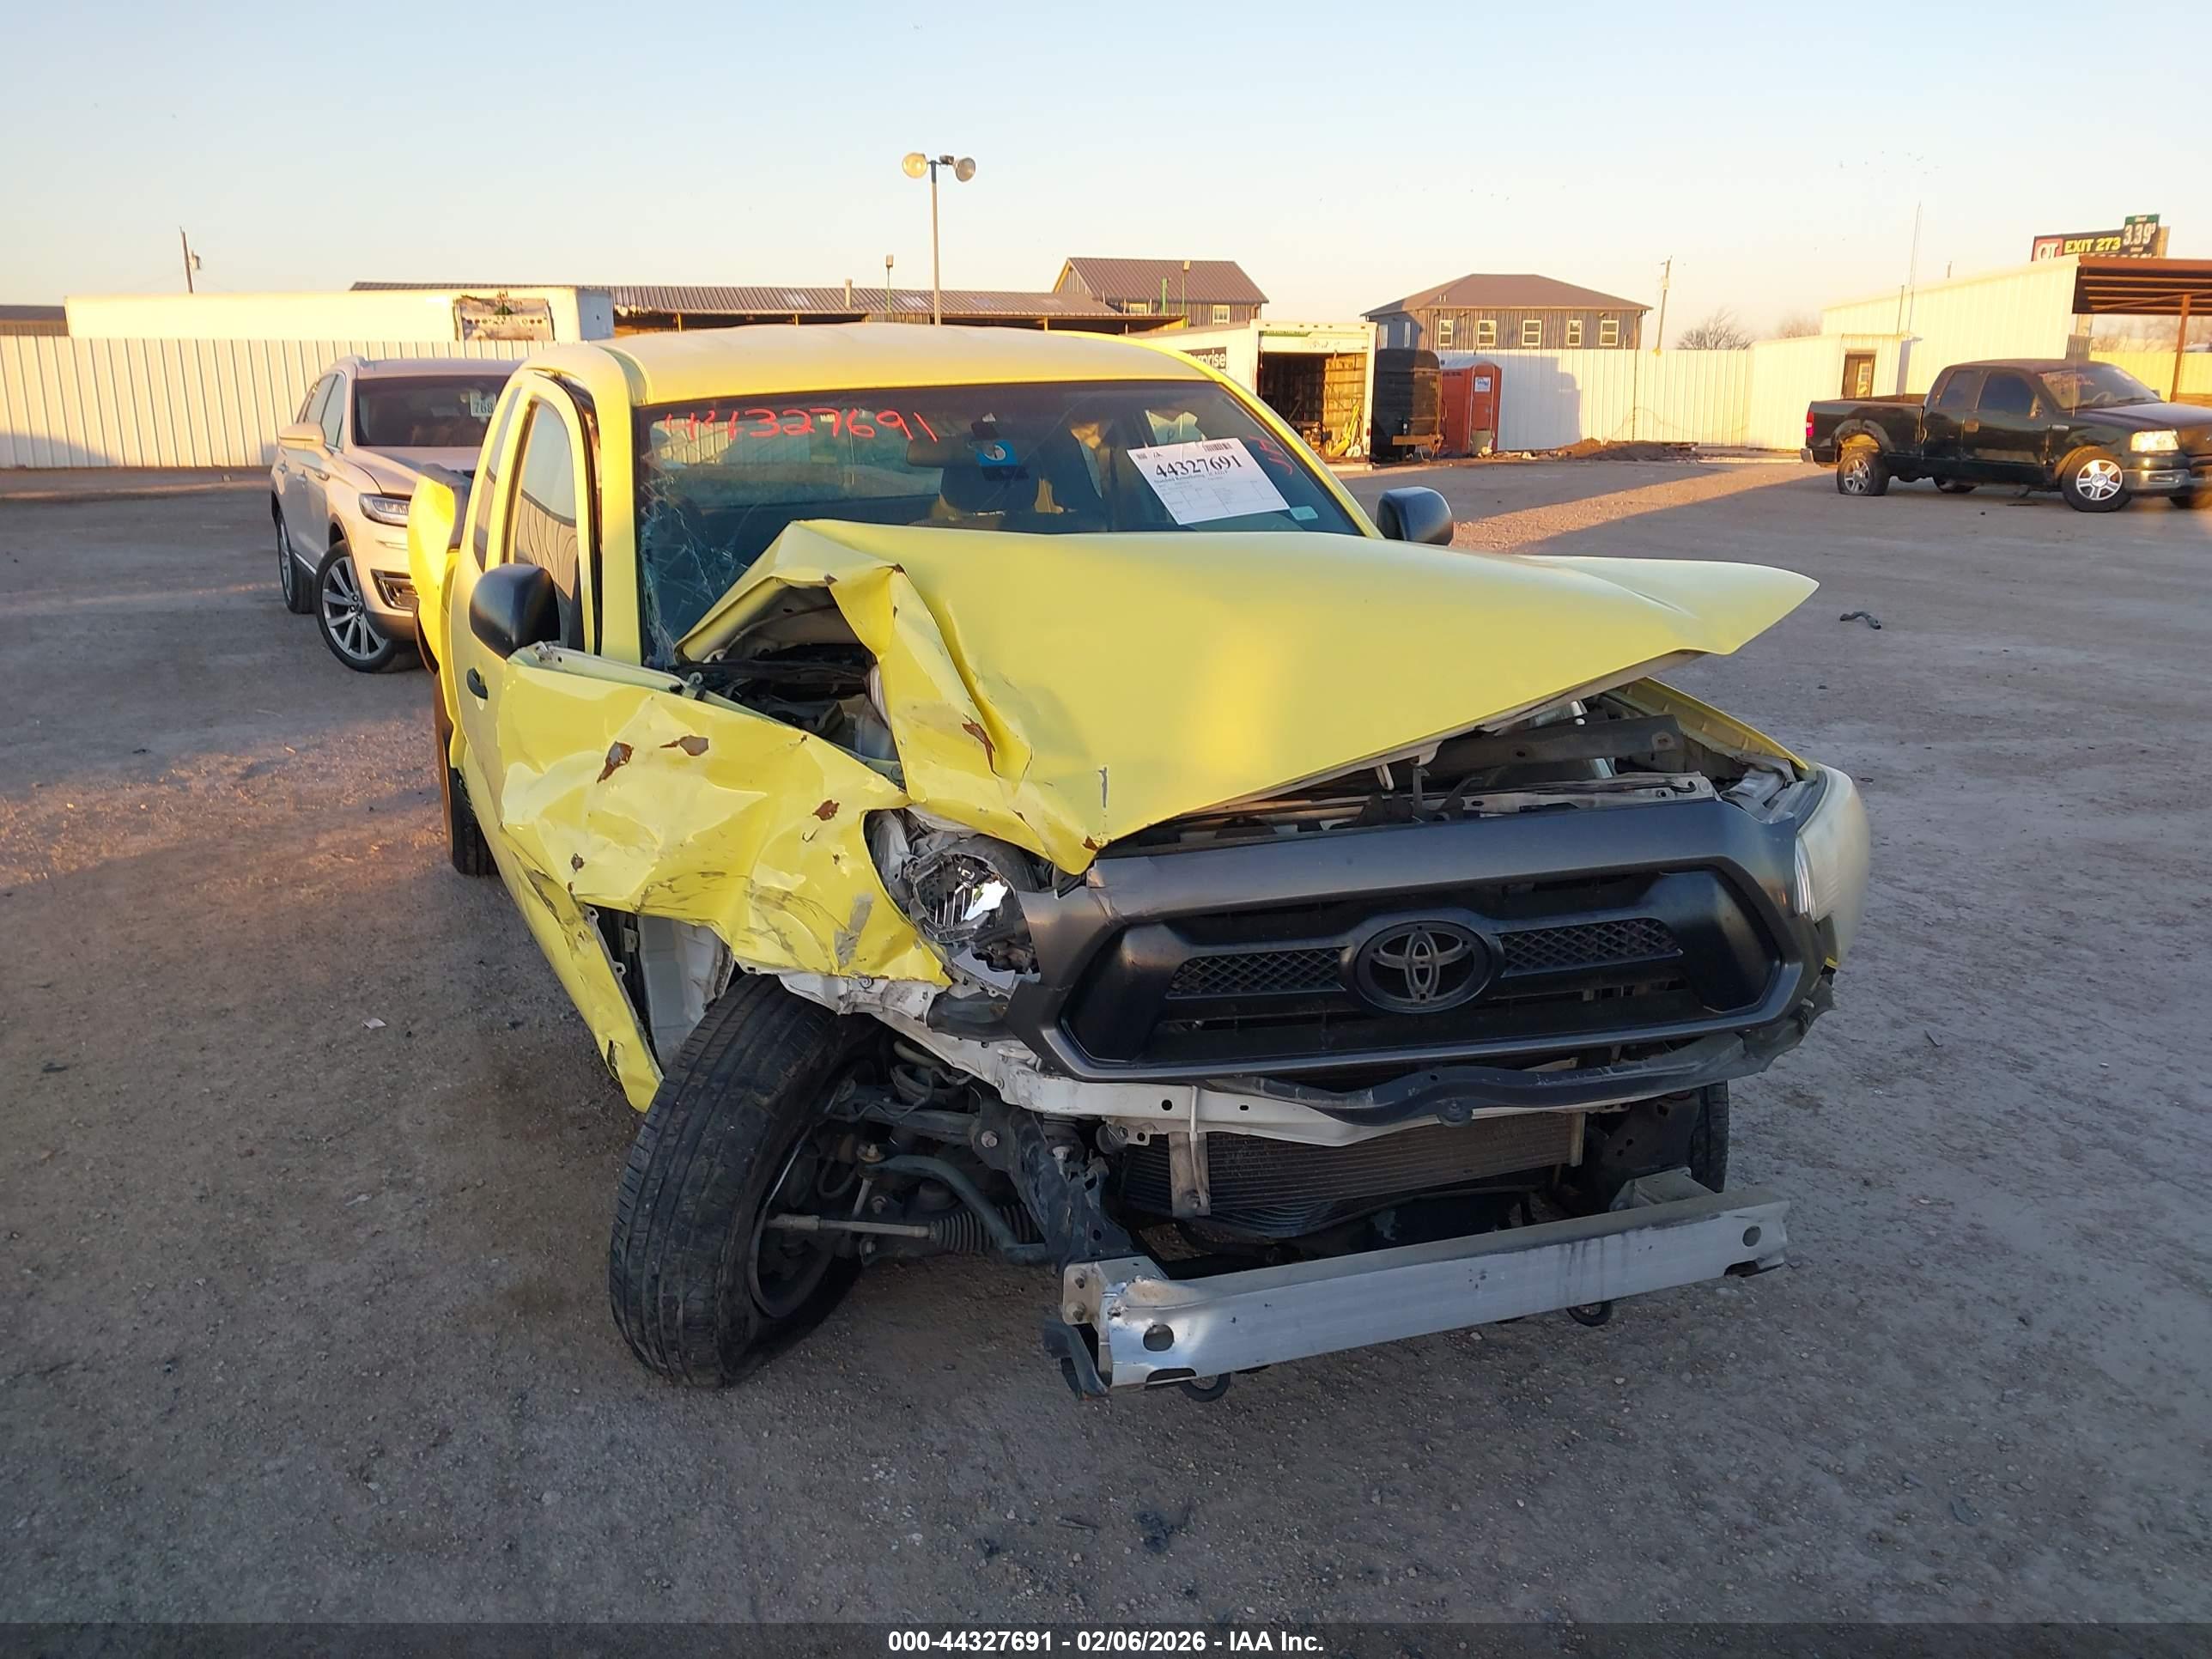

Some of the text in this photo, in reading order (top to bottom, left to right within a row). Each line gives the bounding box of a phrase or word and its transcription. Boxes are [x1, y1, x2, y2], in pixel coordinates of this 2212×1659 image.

[2063, 236, 2121, 253] EXIT 273
[665, 408, 939, 442] 44327691
[1156, 454, 1243, 477] 44327691
